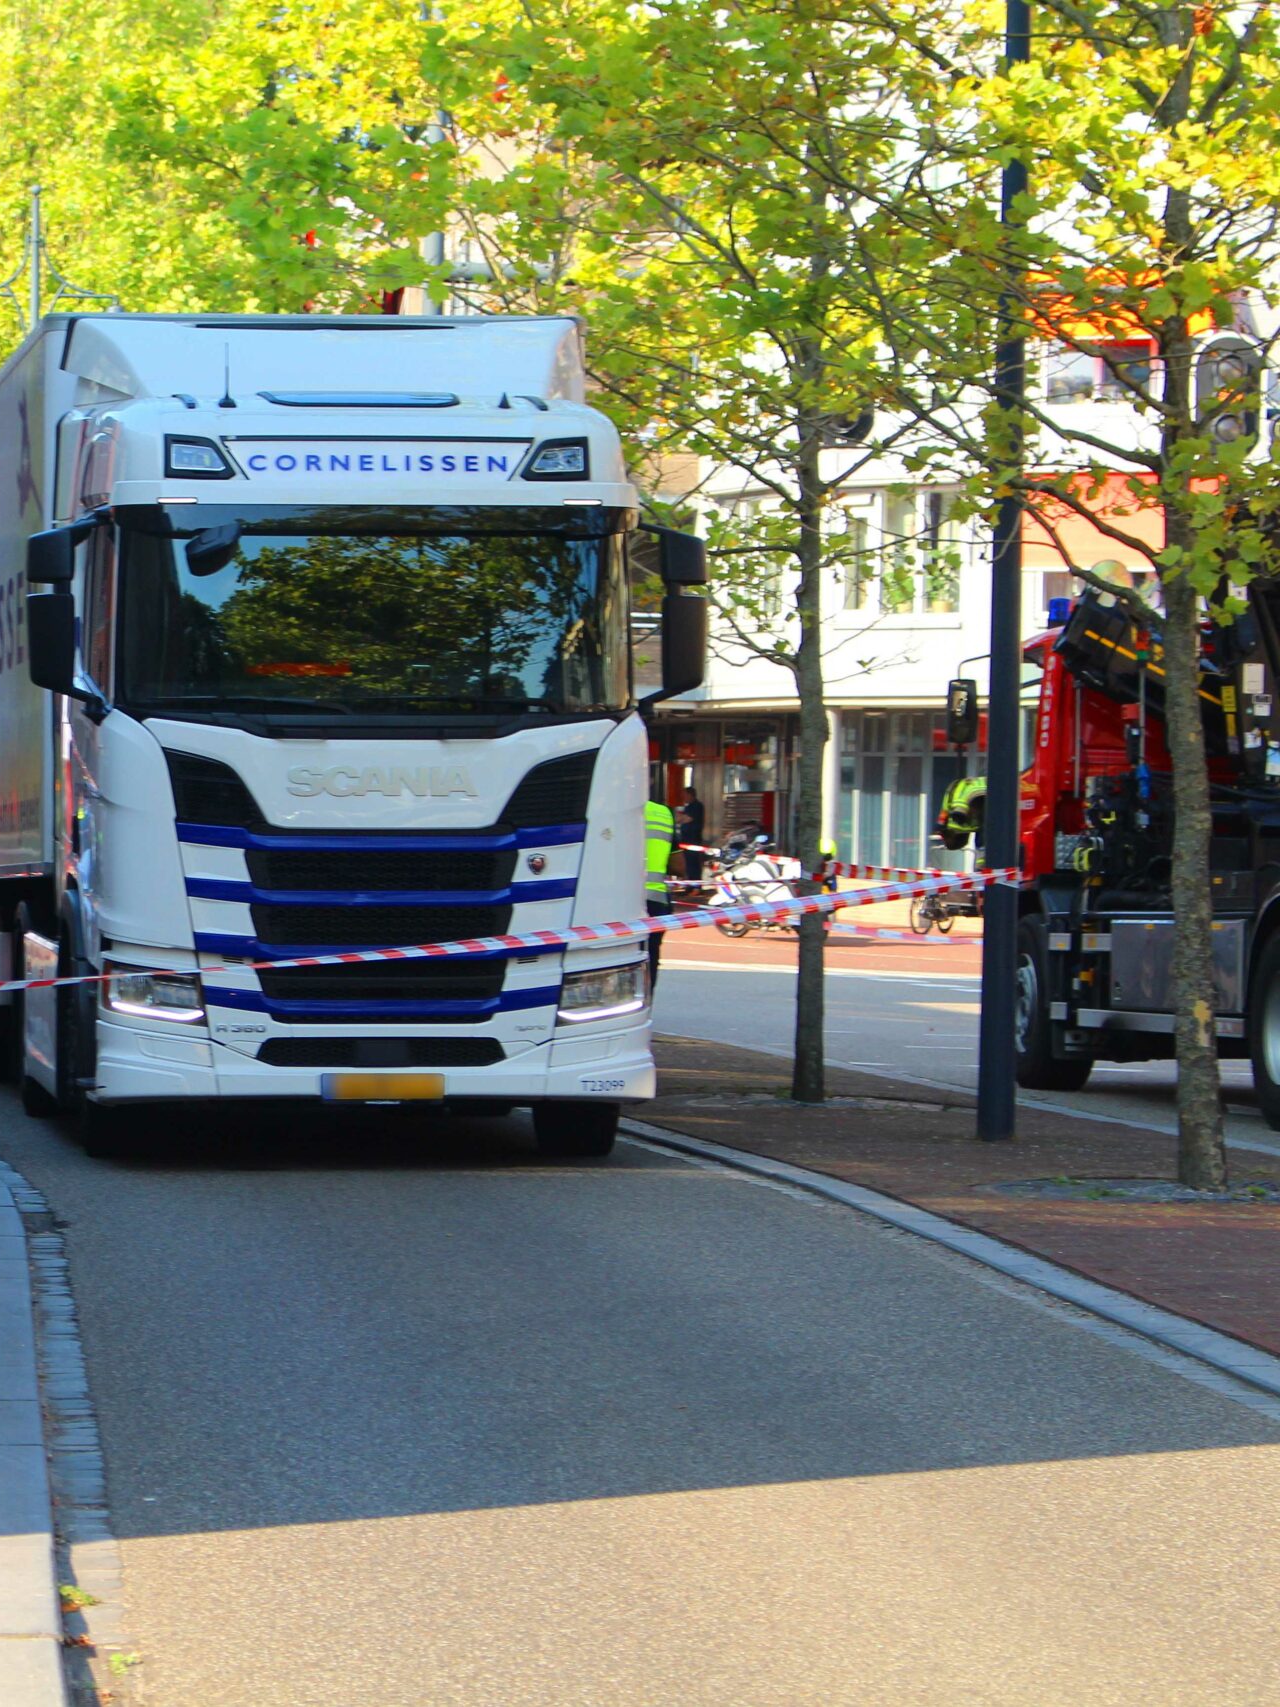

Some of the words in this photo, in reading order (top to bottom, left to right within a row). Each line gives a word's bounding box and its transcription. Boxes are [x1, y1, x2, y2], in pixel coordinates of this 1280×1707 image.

[247, 454, 509, 473] CORNELISSEN
[286, 766, 480, 798] SCANIA
[230, 1023, 267, 1033] 360
[580, 1079, 626, 1092] T23099
